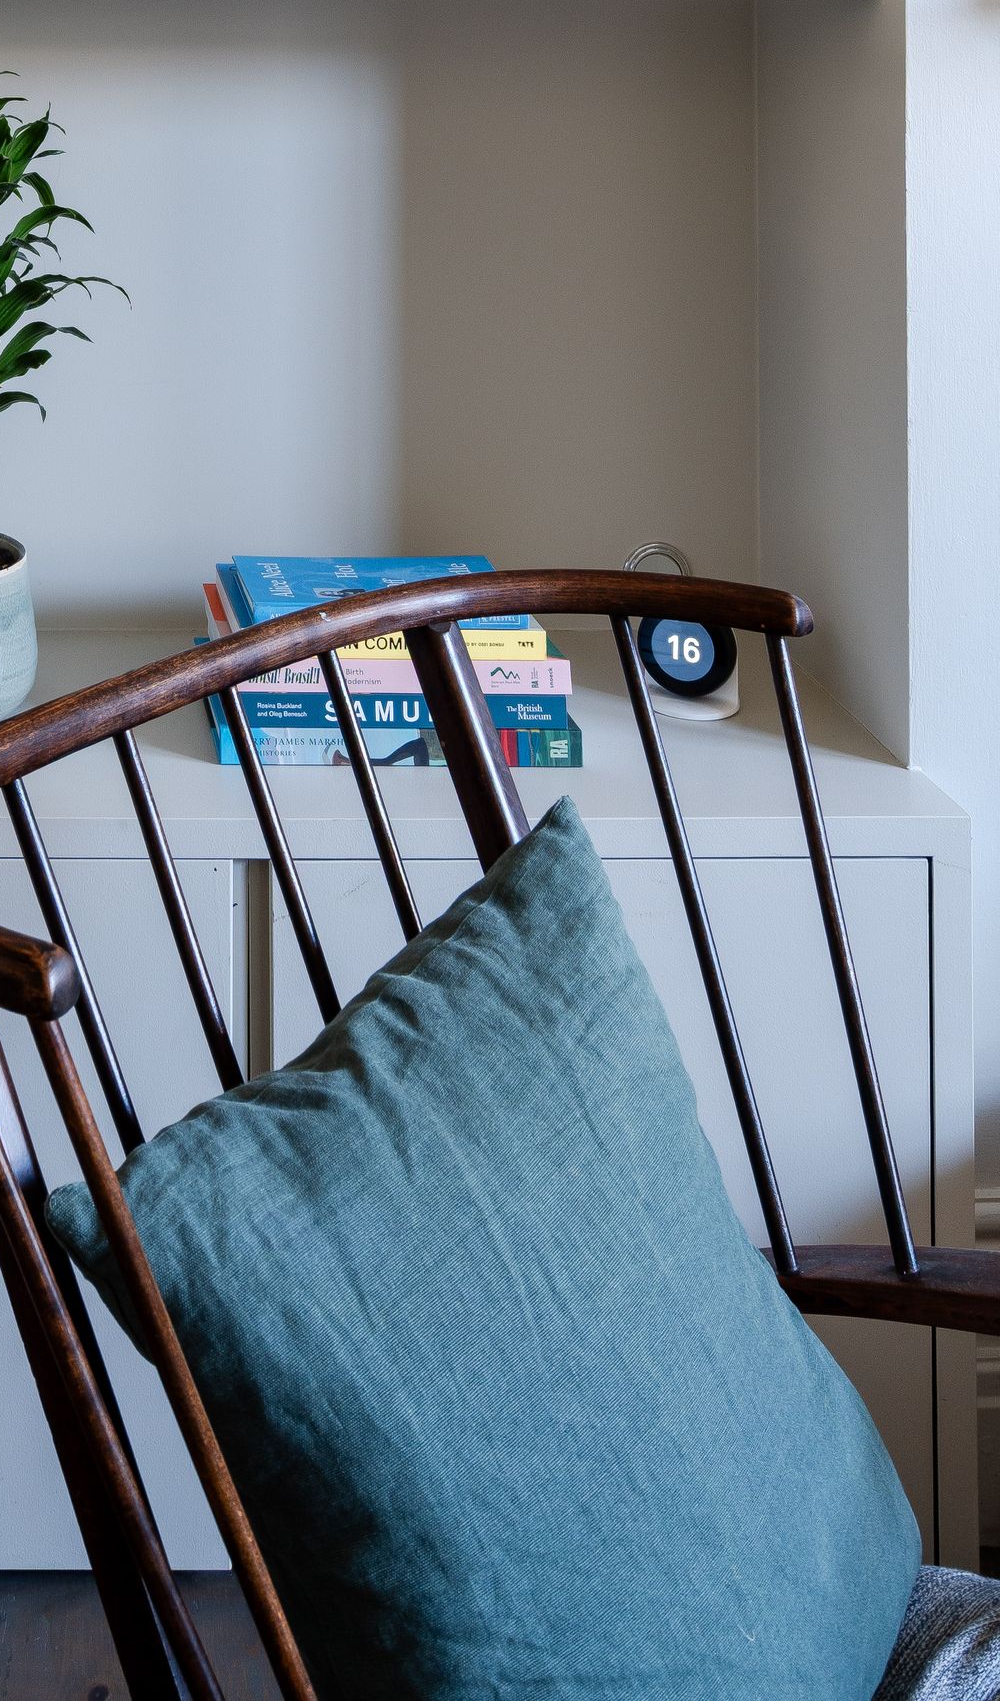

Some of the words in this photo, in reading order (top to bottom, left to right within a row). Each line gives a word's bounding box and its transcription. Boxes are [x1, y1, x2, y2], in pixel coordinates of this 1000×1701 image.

[256, 562, 285, 580] Neel
[334, 564, 359, 579] Hot
[268, 579, 295, 598] Alice
[668, 634, 701, 664] 16
[268, 711, 282, 719] Oleg
[517, 703, 543, 712] British
[517, 712, 552, 721] Museum
[550, 739, 569, 759] RA
